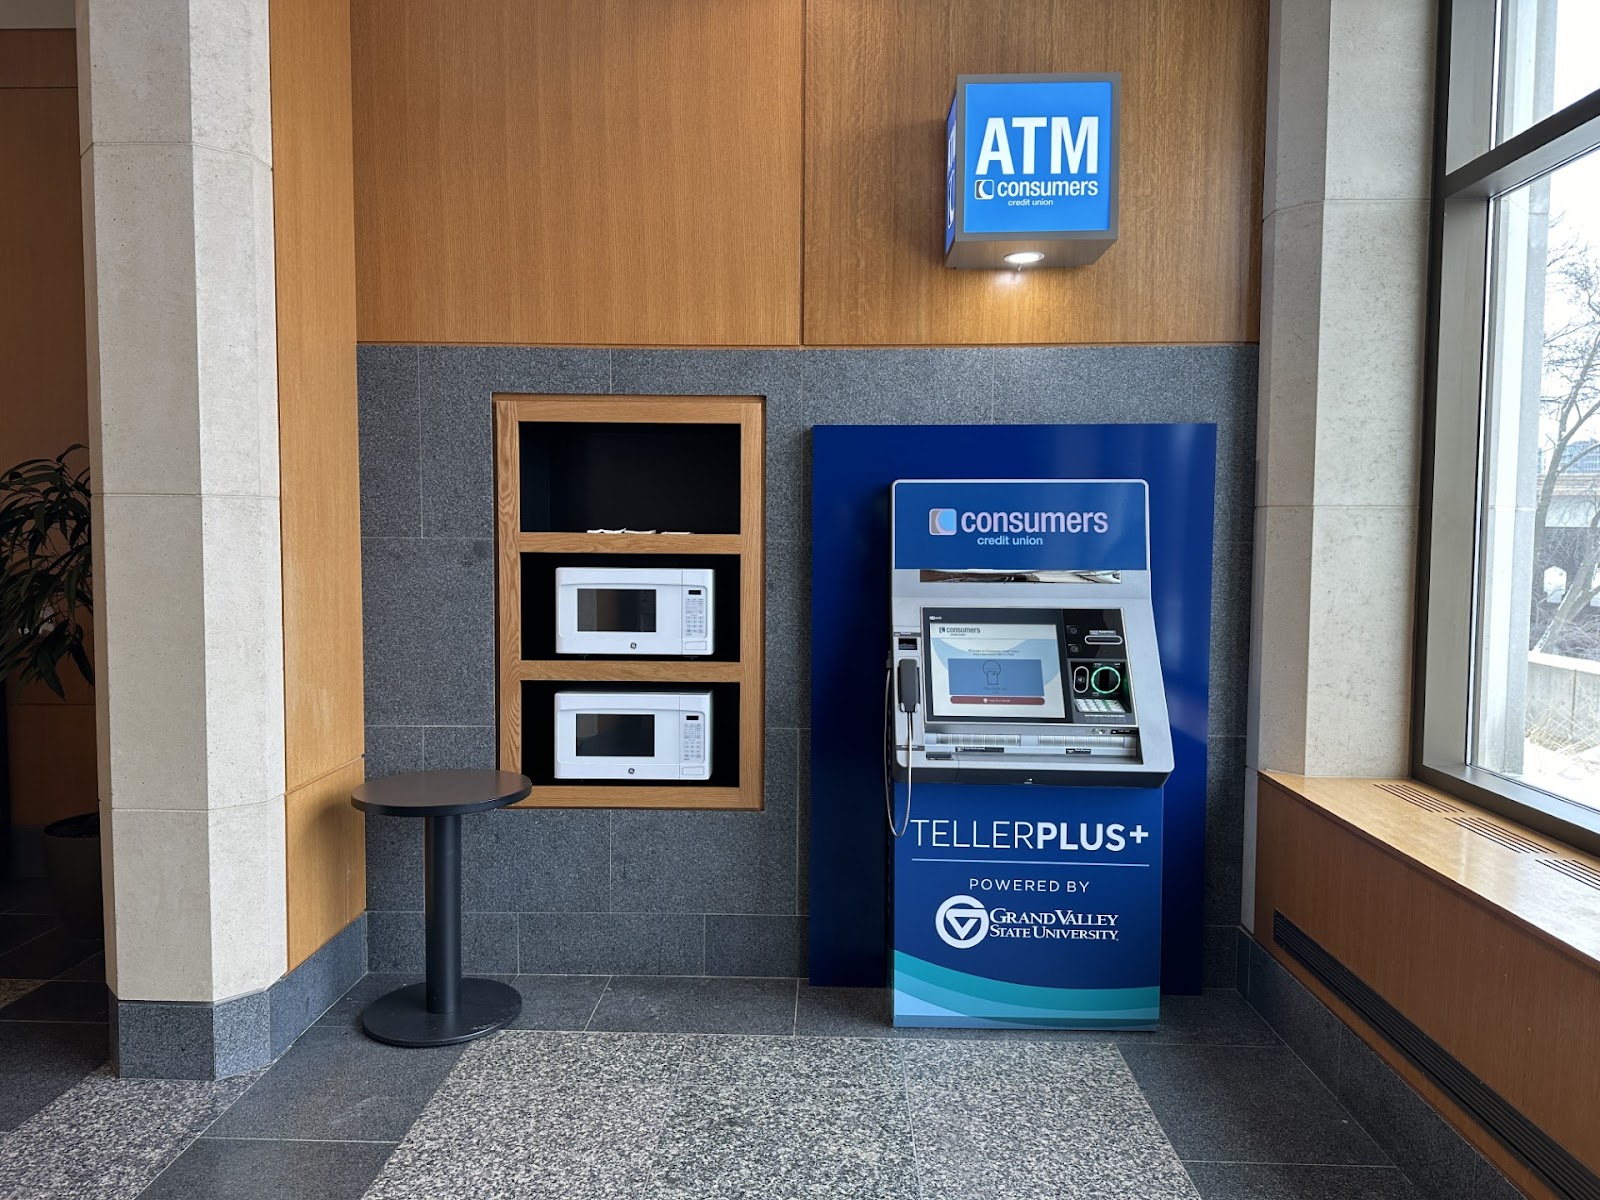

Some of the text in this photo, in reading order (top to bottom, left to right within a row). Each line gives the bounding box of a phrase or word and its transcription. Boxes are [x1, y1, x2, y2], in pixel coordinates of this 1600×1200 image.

[975, 116, 1099, 175] ATM
[997, 179, 1099, 197] consumers
[1007, 198, 1054, 206] credit union
[961, 511, 1109, 534] consumers
[977, 535, 1044, 546] credit union
[946, 626, 981, 634] consumers
[910, 819, 1149, 852] TELLERPLUS+
[969, 878, 1090, 893] POWERED BY
[989, 907, 1119, 926] GRAND VALLEY
[989, 924, 1031, 938] STATE
